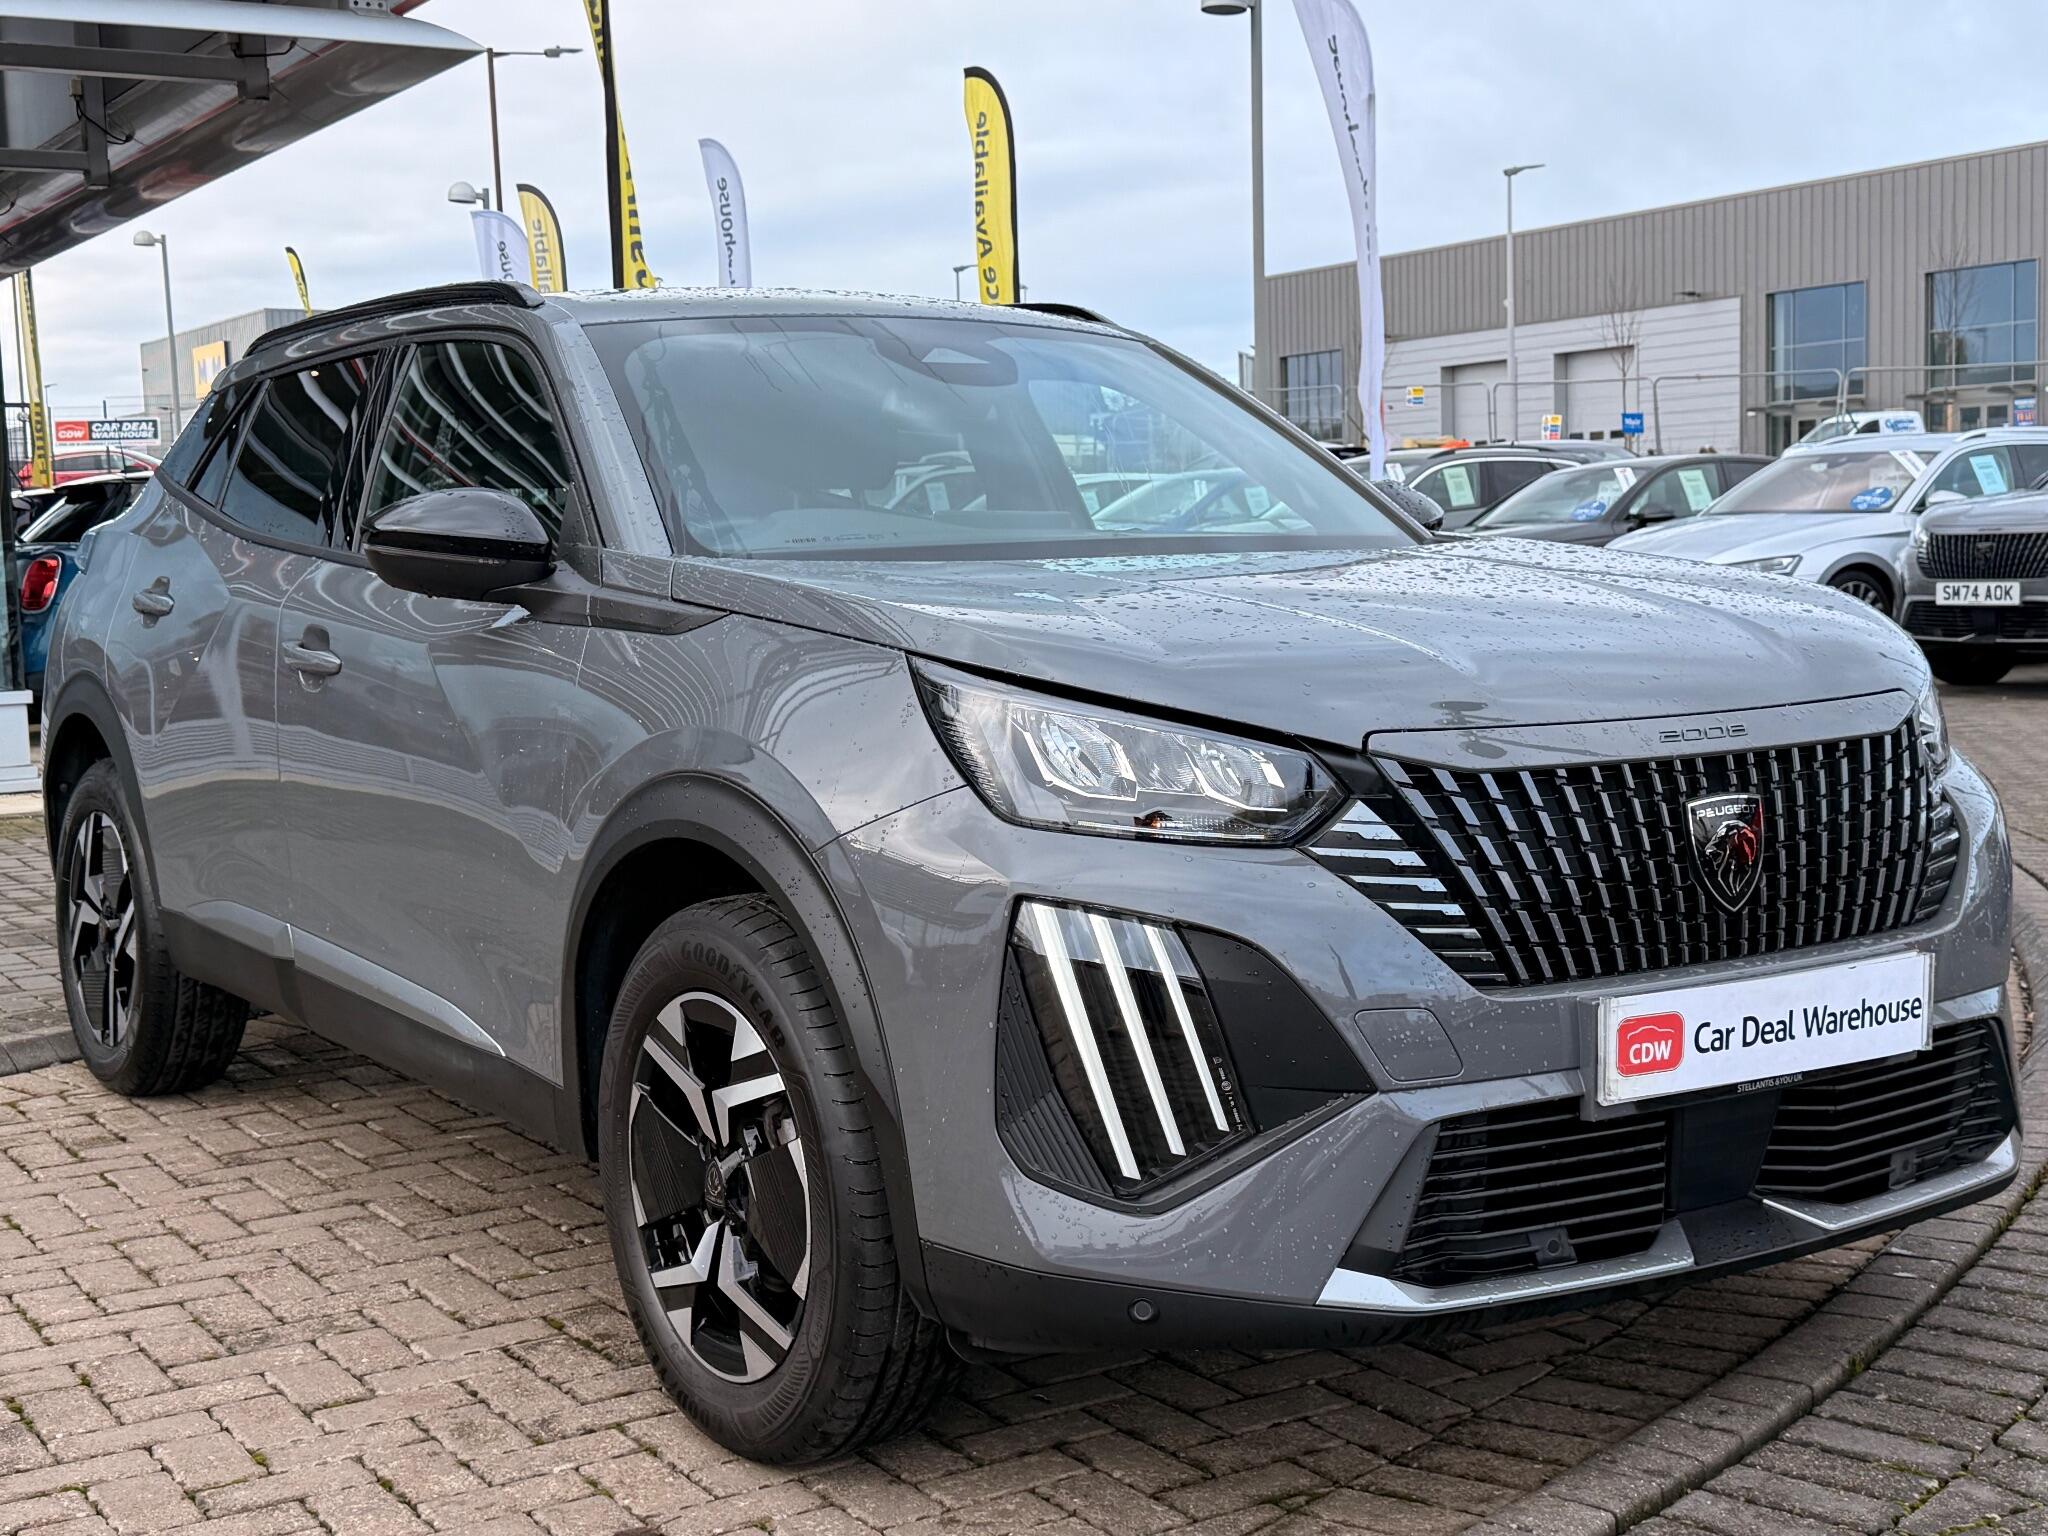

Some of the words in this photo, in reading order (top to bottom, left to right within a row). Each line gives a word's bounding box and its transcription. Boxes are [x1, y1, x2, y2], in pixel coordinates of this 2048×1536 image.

[91, 422, 119, 431] CAR
[121, 421, 155, 431] DEAL
[58, 430, 84, 439] CDW
[91, 431, 154, 439] WAREHOUSE
[1943, 584, 1980, 601] SM74
[1984, 584, 2013, 601] AOK
[1659, 724, 1749, 743] 2008
[1696, 804, 1757, 820] PEUGEOT
[1629, 1039, 1672, 1064] CDW
[1694, 1022, 1736, 1053] Car
[1742, 1009, 1795, 1048] Deal
[1803, 997, 1922, 1038] Warehouse
[1736, 1078, 1775, 1093] STELLANTIS
[1793, 1072, 1803, 1082] UK
